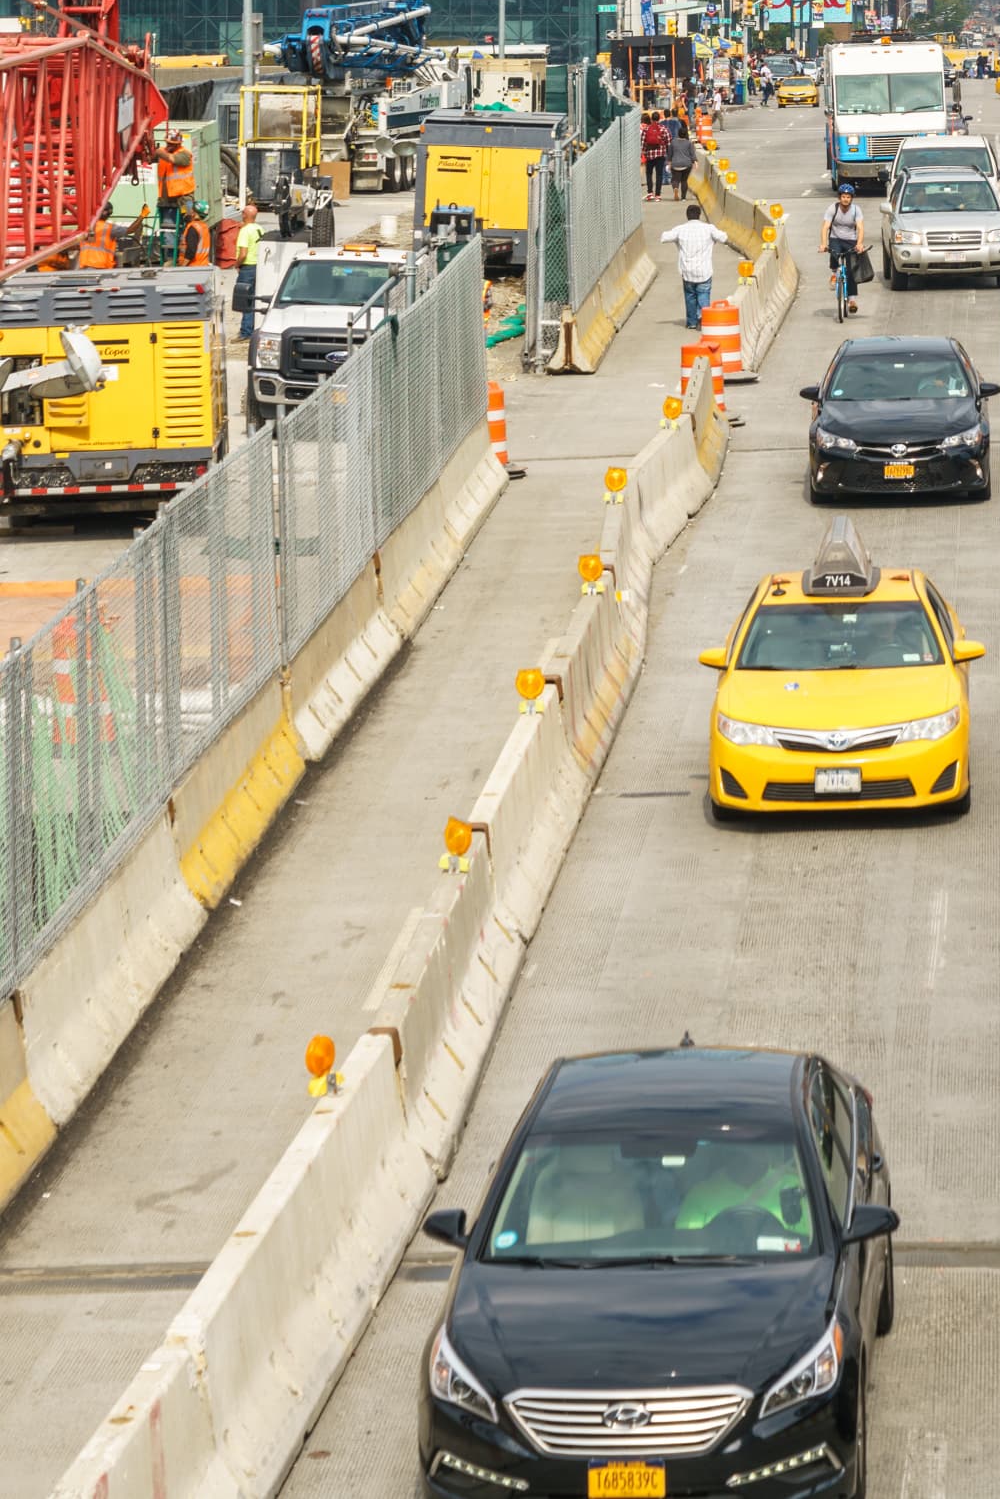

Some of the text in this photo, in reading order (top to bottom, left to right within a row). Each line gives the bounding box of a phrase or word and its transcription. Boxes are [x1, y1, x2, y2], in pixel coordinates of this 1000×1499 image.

[104, 347, 130, 357] Copco
[825, 575, 852, 587] 7V14
[597, 1470, 658, 1490] T685839C
